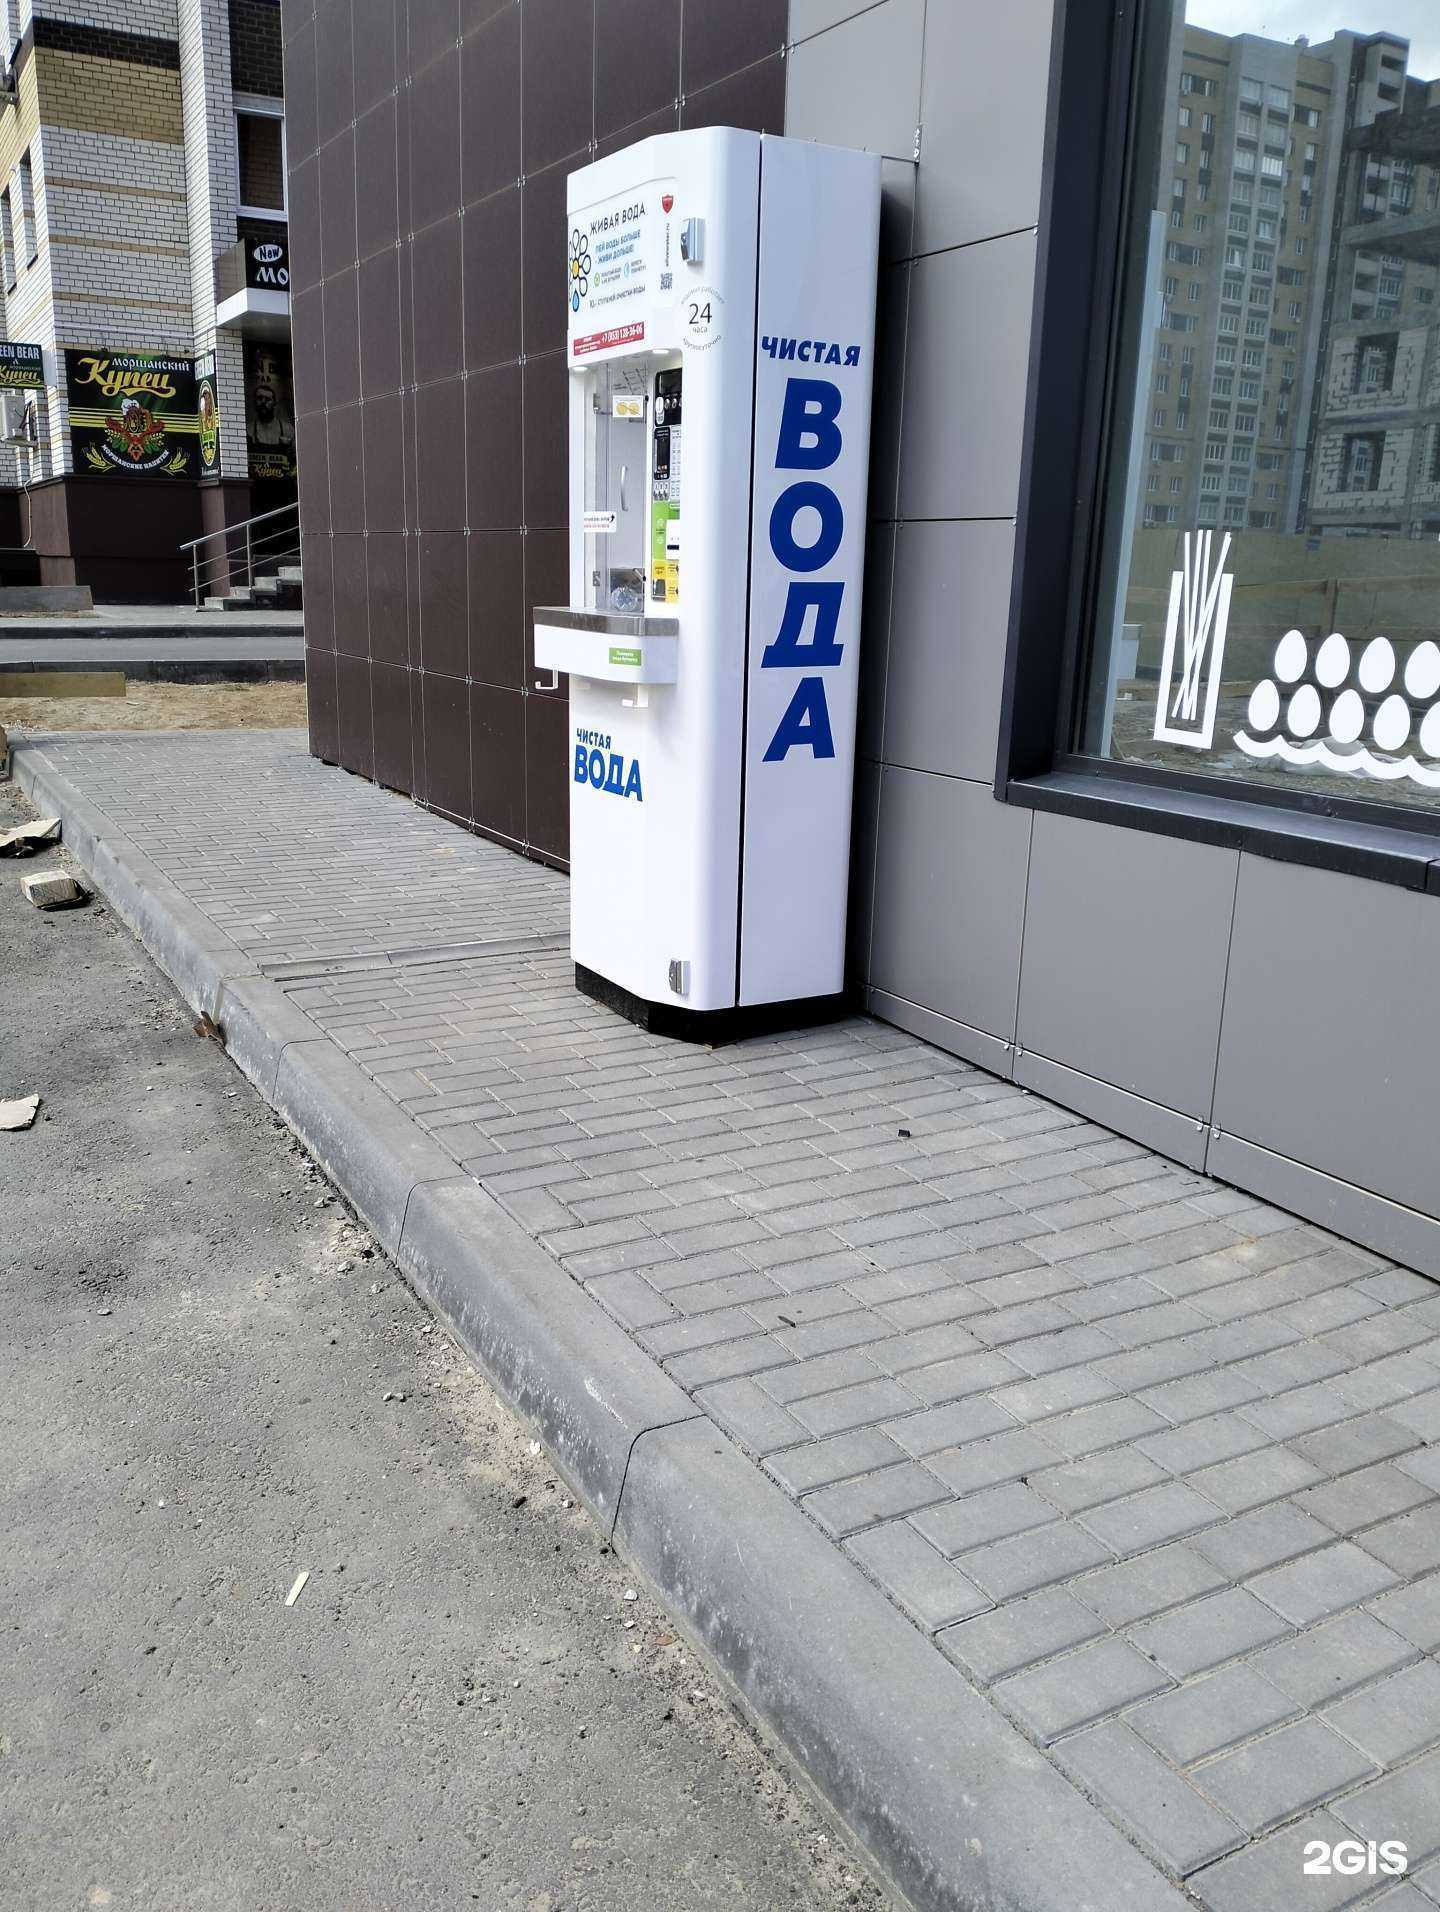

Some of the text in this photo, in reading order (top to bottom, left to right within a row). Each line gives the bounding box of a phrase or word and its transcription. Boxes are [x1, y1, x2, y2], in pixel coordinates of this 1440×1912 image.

[590, 202, 646, 237] ЖИВАЯ ВОДА
[259, 246, 279, 260] New
[689, 302, 713, 325] 24
[17, 346, 40, 359] BEAR
[761, 336, 861, 366] ЧИСТАЯ
[74, 357, 177, 398] Купец
[112, 357, 191, 372] Моршанский
[760, 376, 846, 763] ВОДА
[576, 728, 612, 750] ЧИСТАЯ
[574, 744, 643, 802] ВОДА
